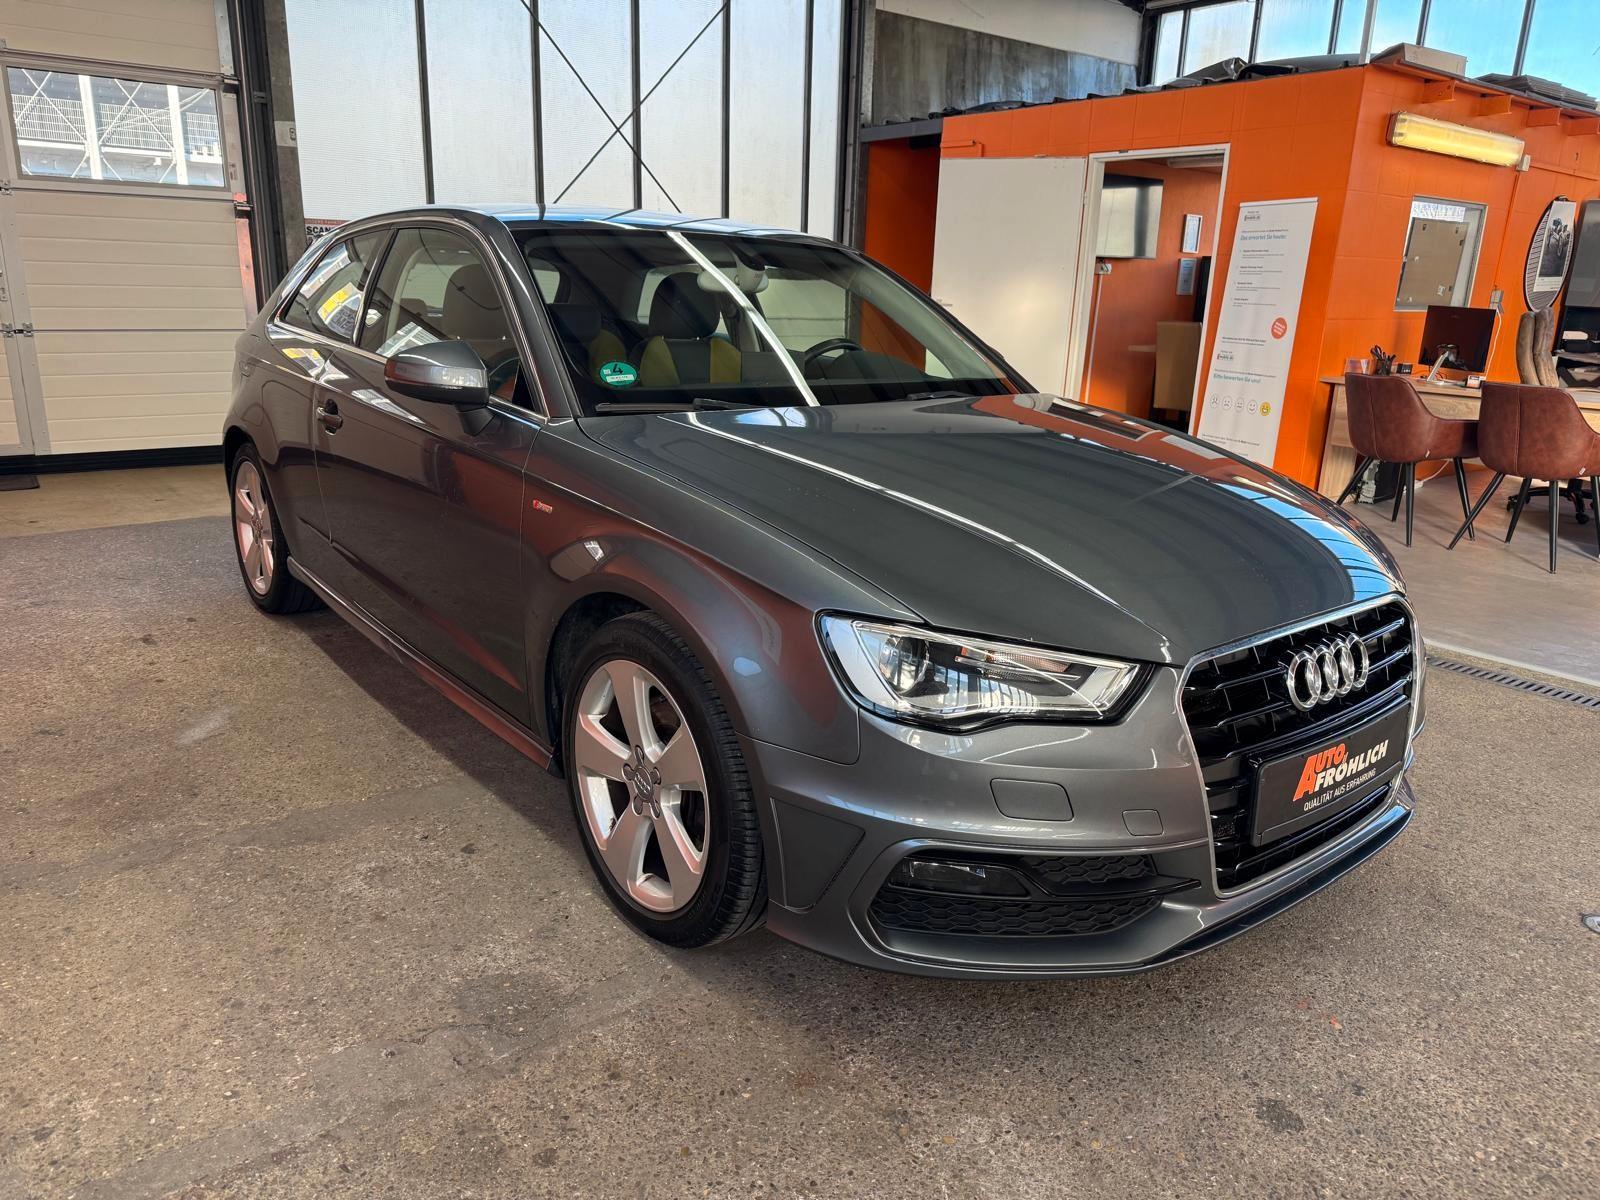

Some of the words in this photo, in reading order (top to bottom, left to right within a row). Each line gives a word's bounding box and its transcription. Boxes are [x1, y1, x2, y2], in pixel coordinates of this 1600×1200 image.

[612, 363, 624, 374] 4
[1224, 373, 1245, 381] bewerten
[1293, 743, 1346, 802] AUTO
[1313, 740, 1389, 792] FRÖHLICH
[1303, 790, 1333, 812] QUALITÄT
[1333, 784, 1346, 798] AUS
[1346, 767, 1377, 791] ERFAHRUNG
